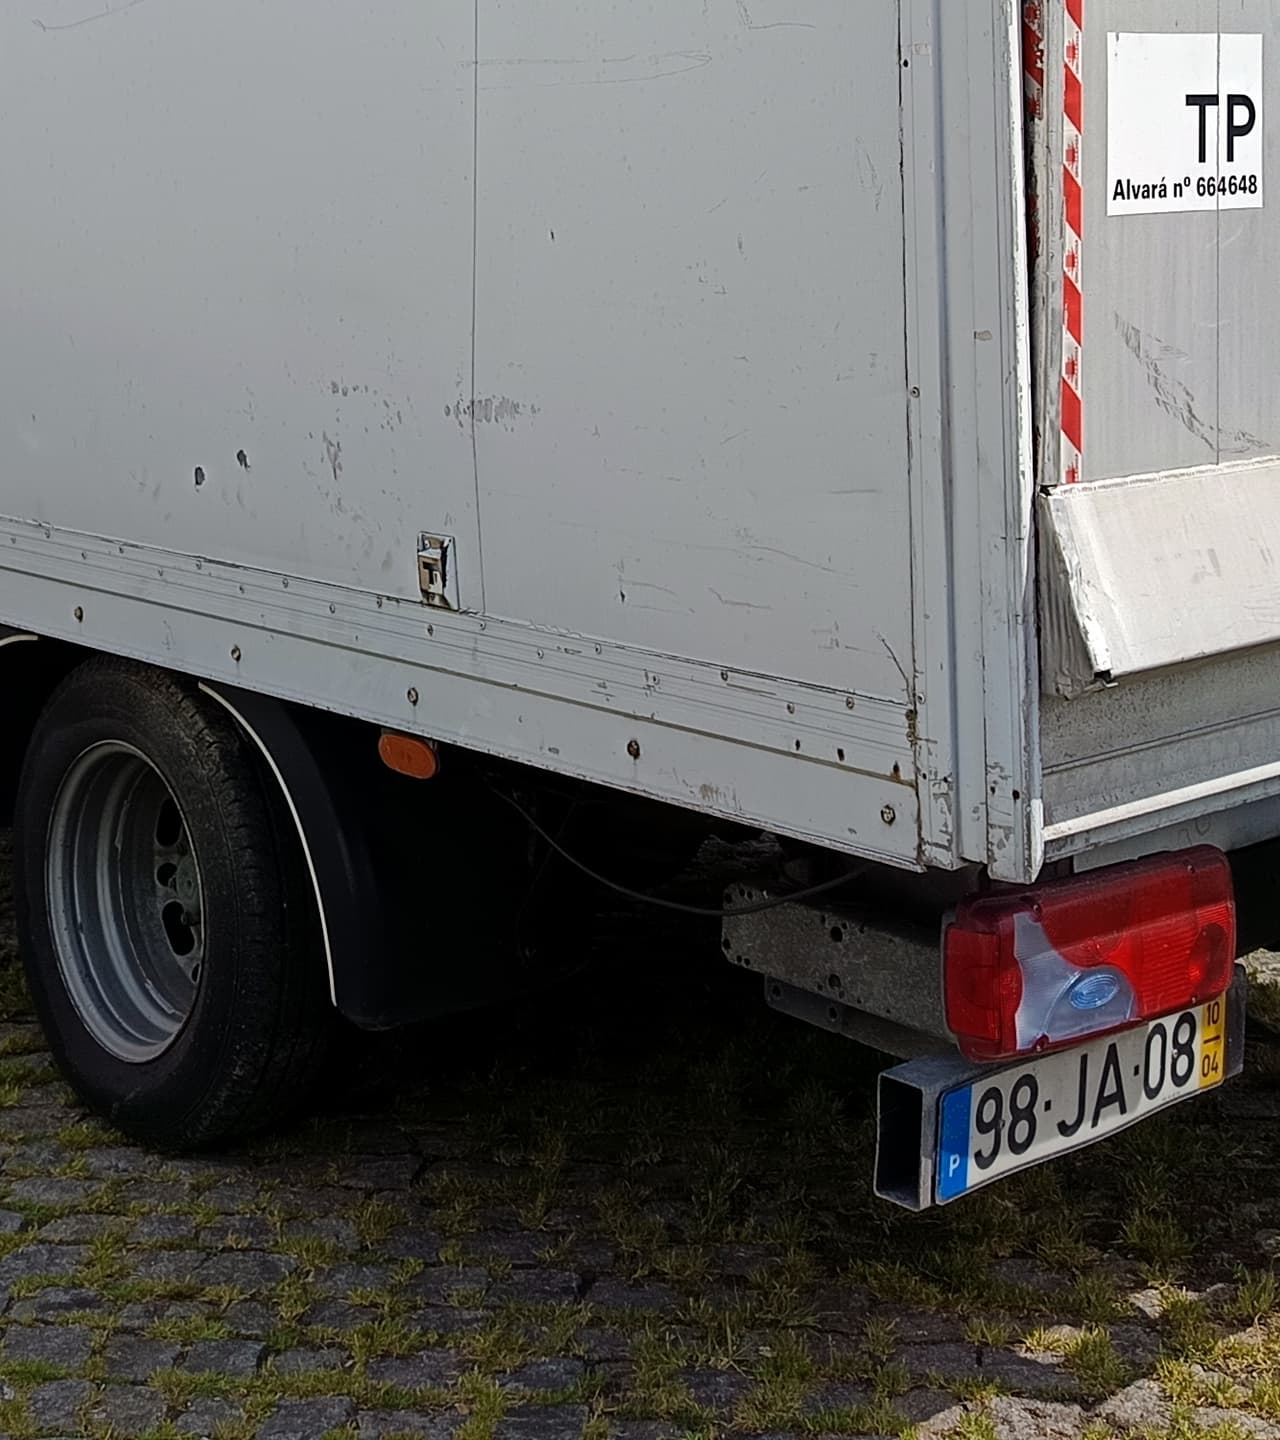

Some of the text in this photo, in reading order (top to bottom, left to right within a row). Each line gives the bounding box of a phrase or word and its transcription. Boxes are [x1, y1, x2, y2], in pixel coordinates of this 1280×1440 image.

[1185, 93, 1256, 163] TP
[1112, 177, 1167, 201] Alvará
[1196, 174, 1258, 197] 664648
[1206, 1001, 1220, 1027] 10
[1201, 1050, 1219, 1078] 04
[949, 1154, 960, 1178] P
